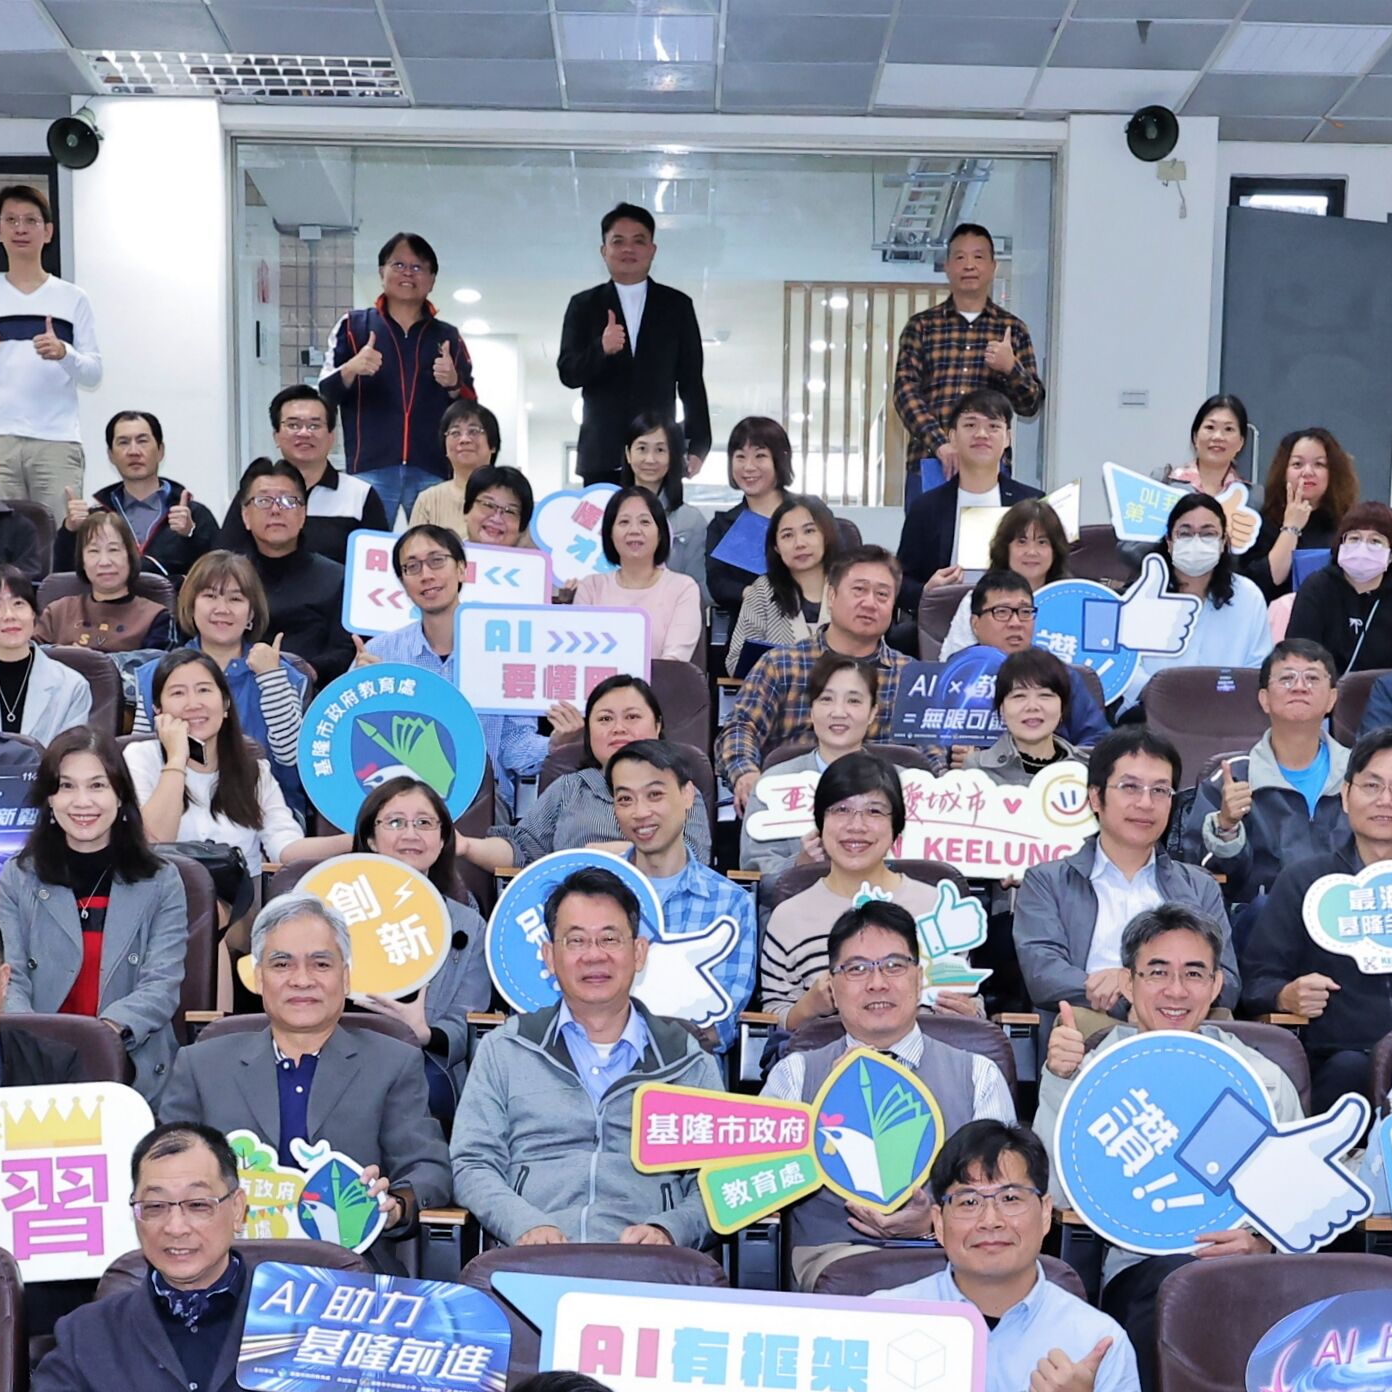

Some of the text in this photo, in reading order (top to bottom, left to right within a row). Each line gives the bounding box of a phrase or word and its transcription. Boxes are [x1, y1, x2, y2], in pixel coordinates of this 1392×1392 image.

[485, 620, 532, 653] AI
[909, 674, 938, 698] AI
[312, 676, 417, 778] 基隆市政府教育處
[646, 1112, 806, 1146] 基隆市政府
[720, 1161, 806, 1209] 教育處
[259, 1279, 425, 1329] AI 助力
[293, 1326, 494, 1382] 基隆前進
[1312, 1327, 1358, 1368] AI
